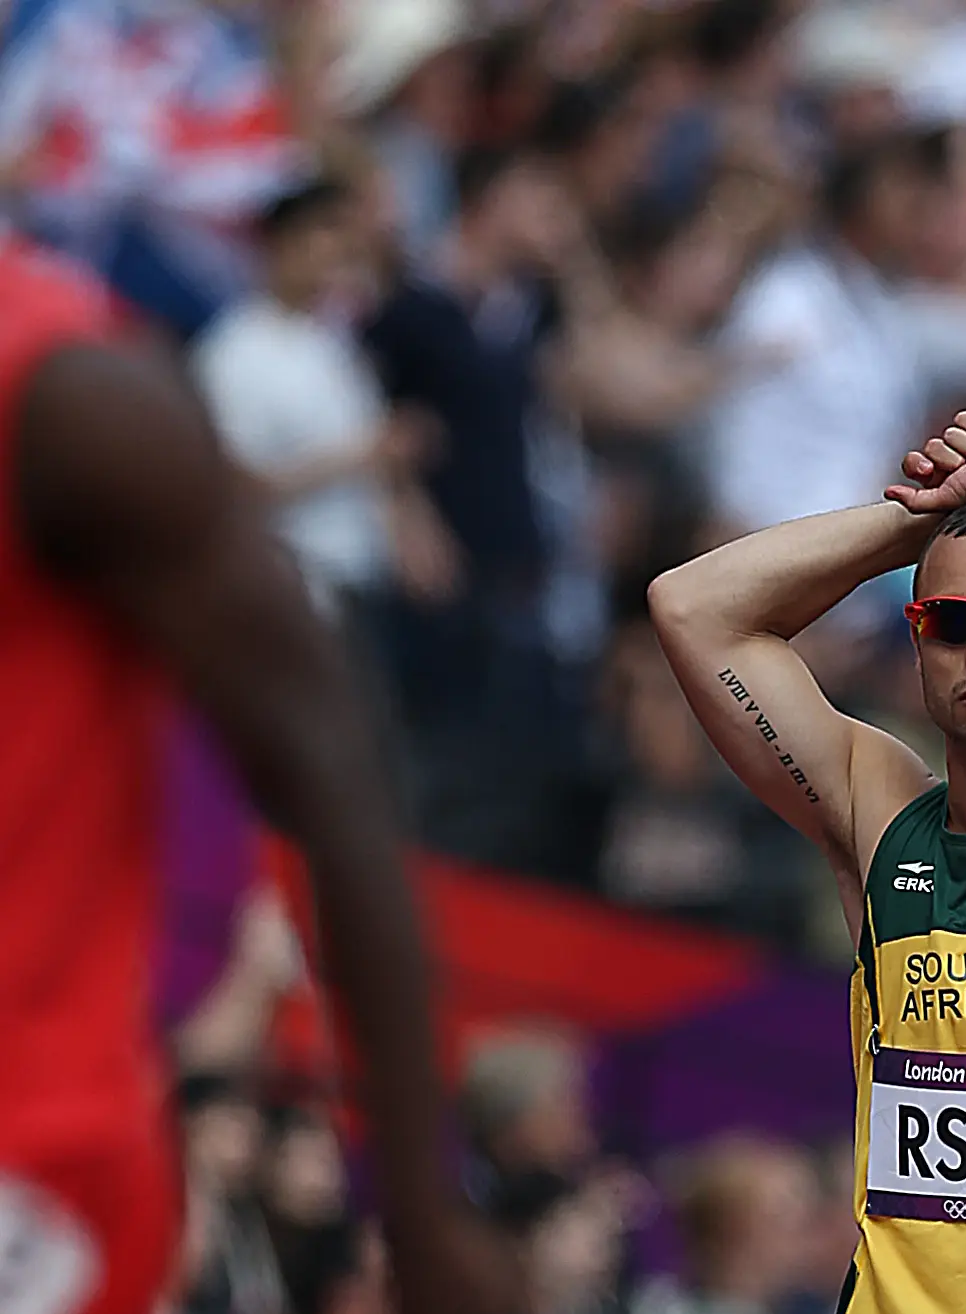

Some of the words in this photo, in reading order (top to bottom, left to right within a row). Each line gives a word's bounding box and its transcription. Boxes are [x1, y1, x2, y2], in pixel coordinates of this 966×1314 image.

[718, 668, 750, 702] LVIII
[745, 700, 759, 712] V
[755, 712, 778, 743] VIII
[778, 753, 794, 768] II
[893, 876, 934, 893] ERK
[904, 1059, 966, 1083] London
